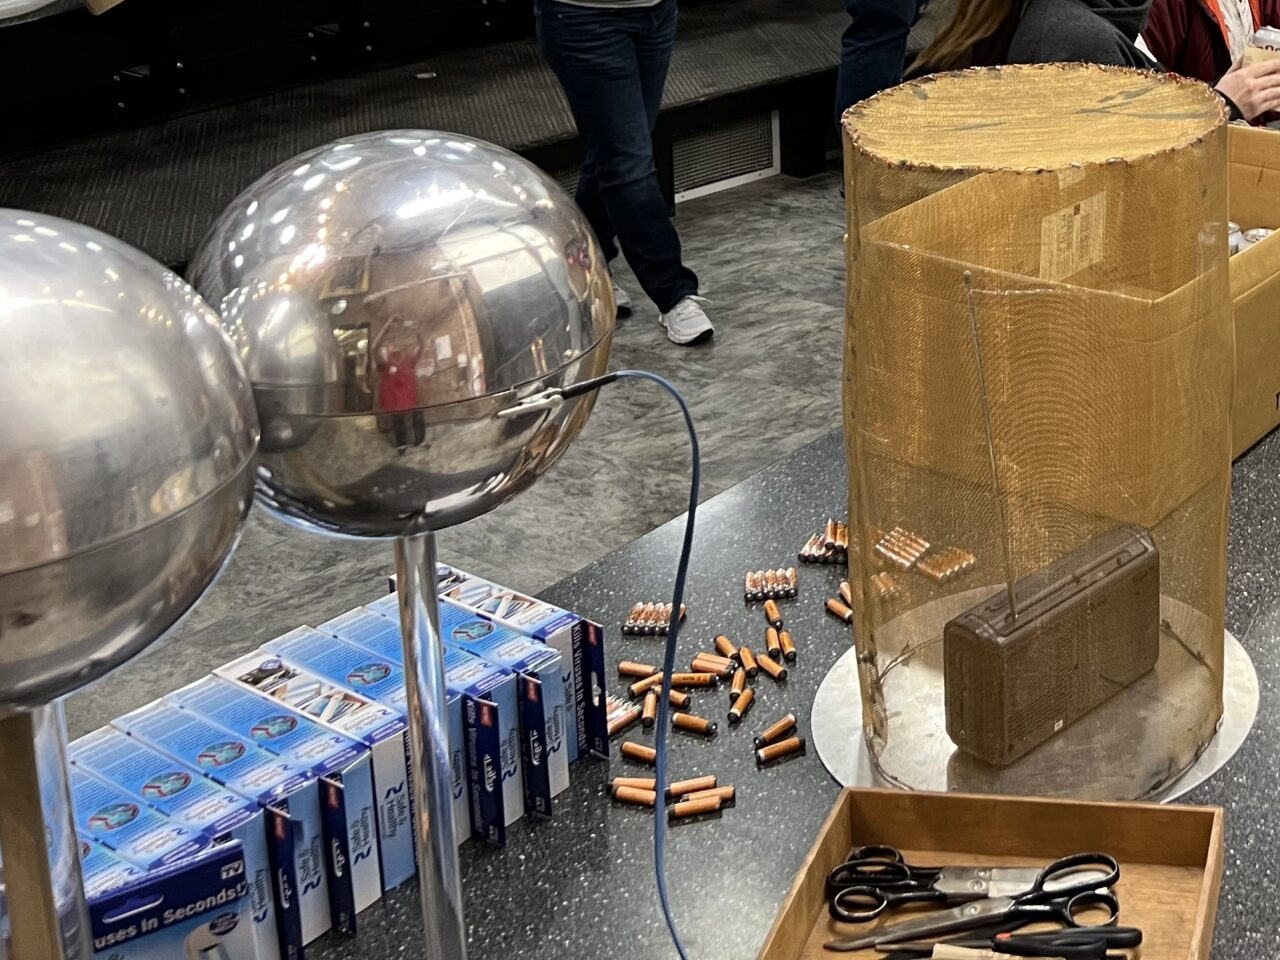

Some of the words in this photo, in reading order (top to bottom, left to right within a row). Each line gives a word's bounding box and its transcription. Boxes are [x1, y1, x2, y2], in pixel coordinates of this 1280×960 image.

[573, 624, 582, 648] Kills
[574, 648, 585, 690] Viruses
[466, 699, 476, 724] Kills
[576, 689, 585, 702] In
[551, 705, 561, 741] Healthy
[507, 727, 516, 765] Healthy
[386, 799, 398, 839] Healthy
[397, 794, 407, 817] Safe
[352, 829, 362, 852] Safe
[360, 806, 371, 848] Healthy
[299, 858, 309, 882] Safe
[309, 835, 320, 877] Healthy
[94, 926, 137, 950] uses
[141, 917, 159, 933] In
